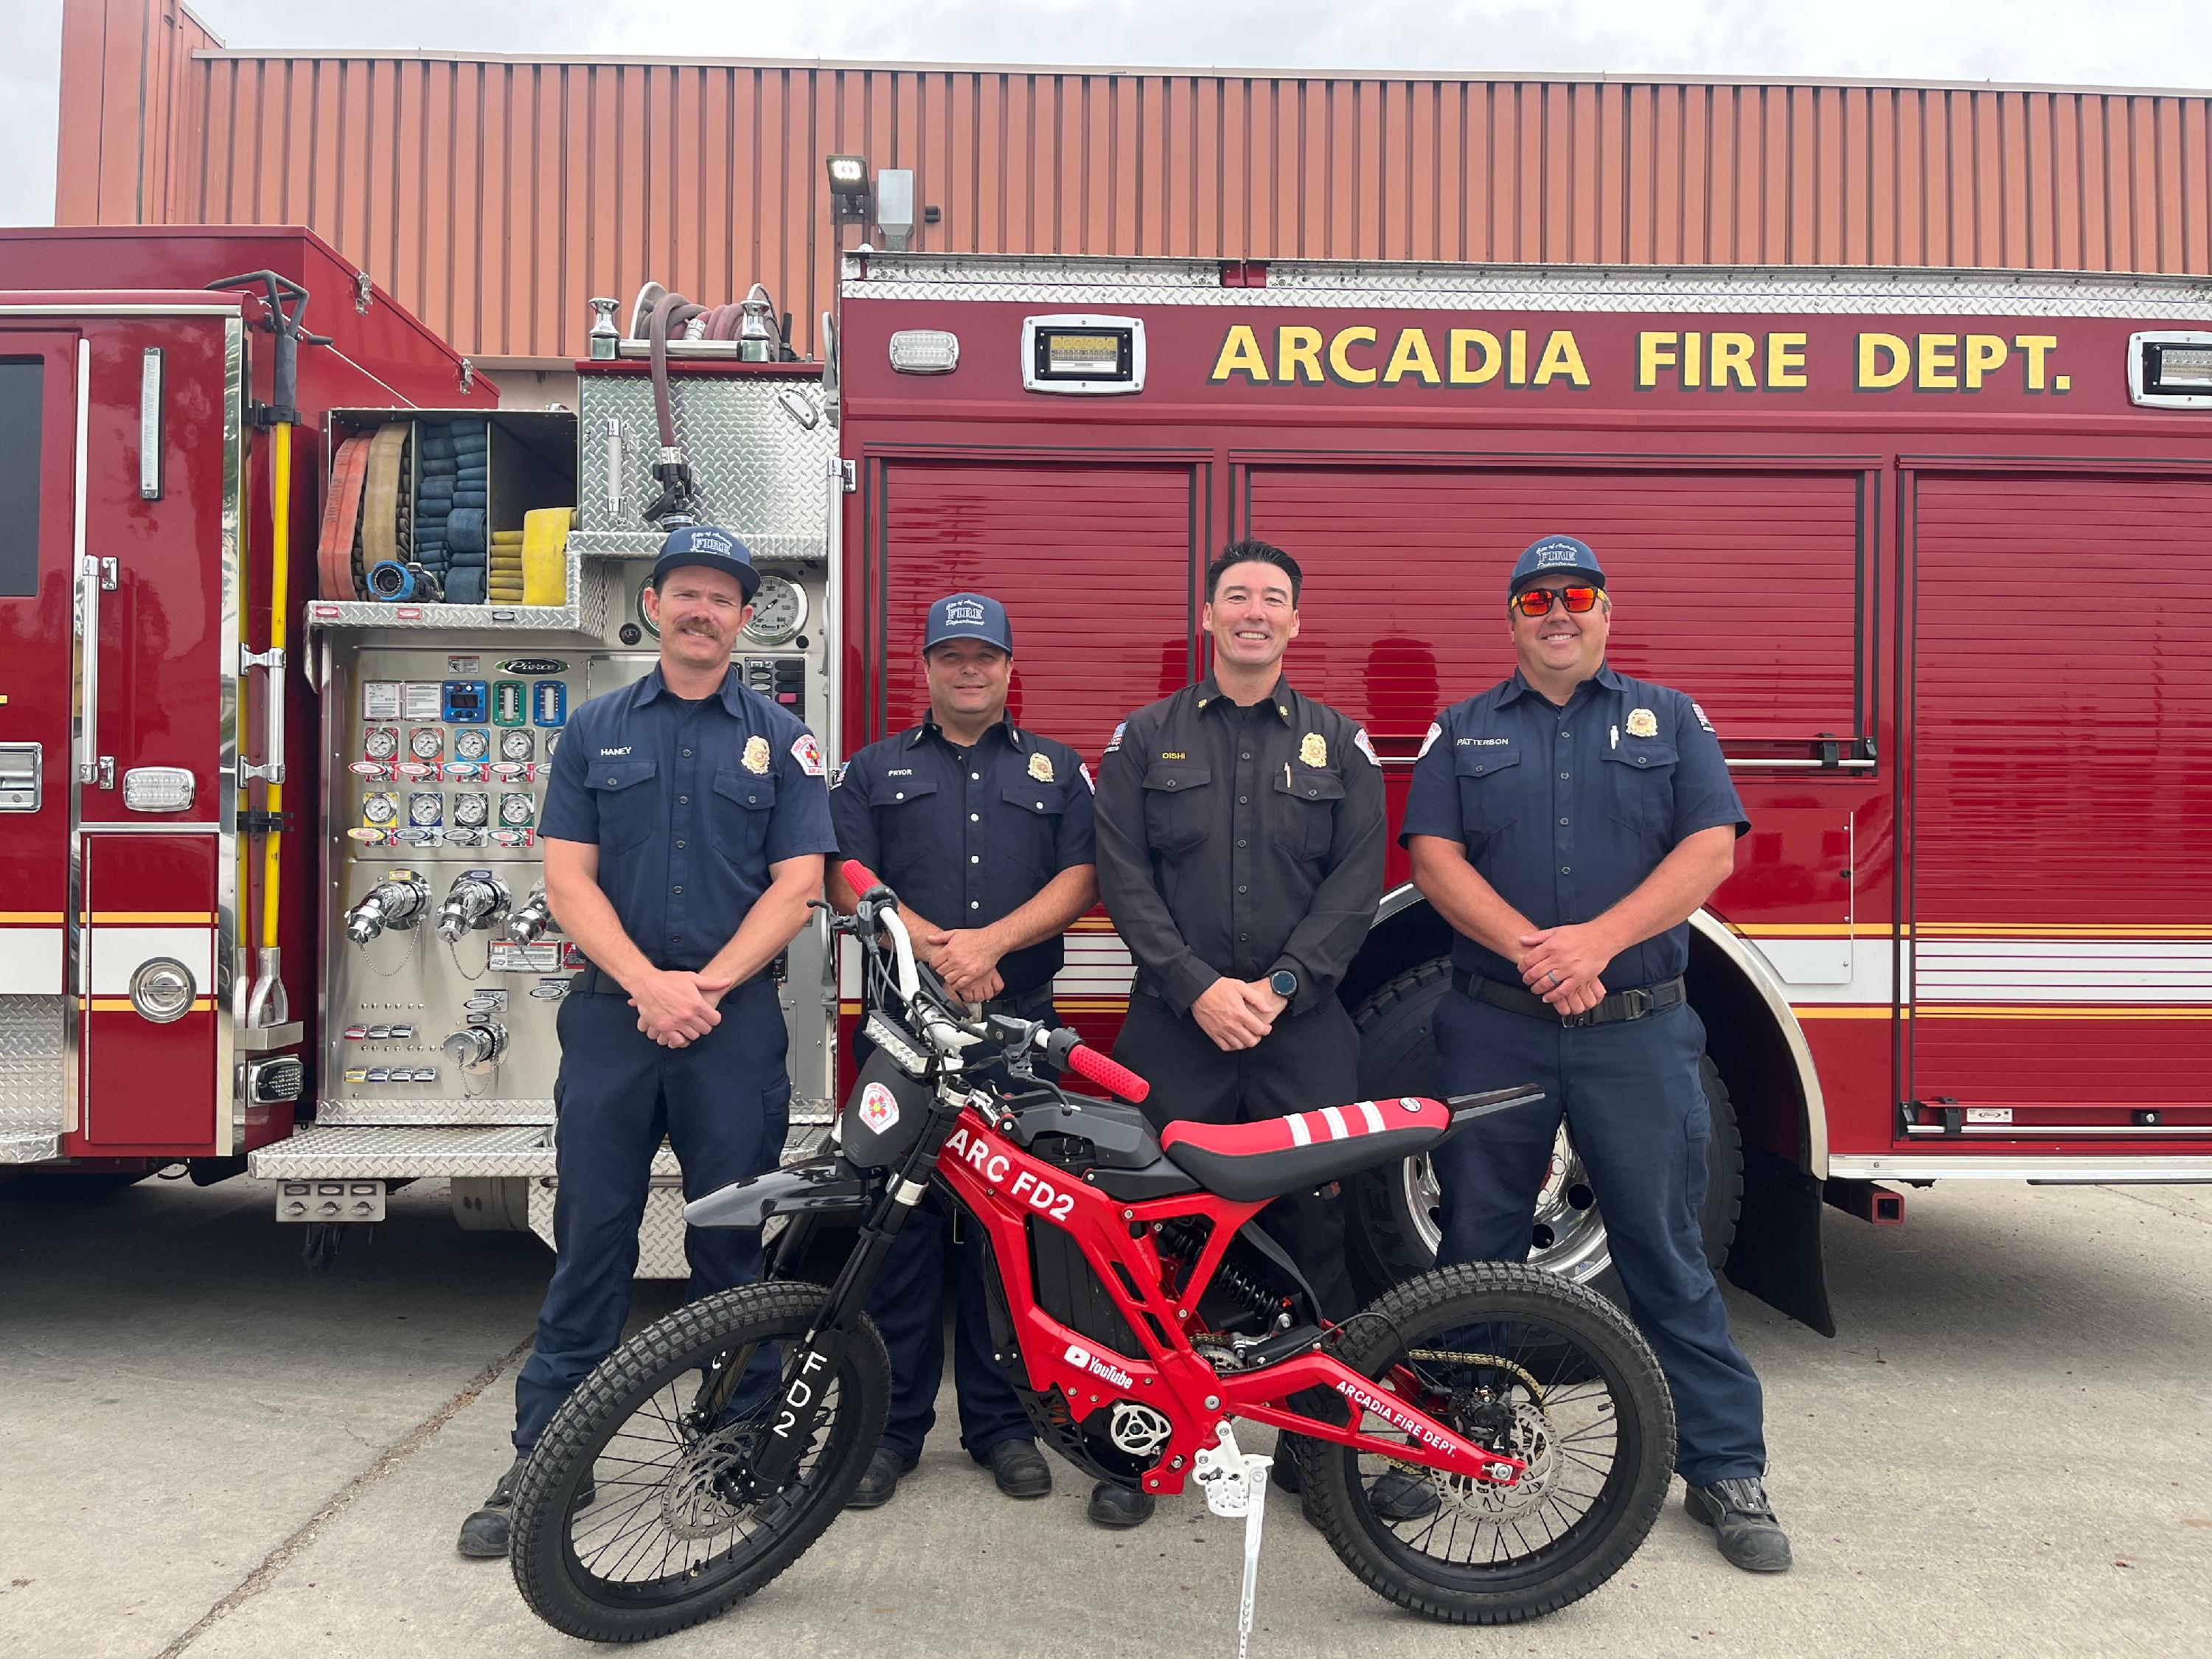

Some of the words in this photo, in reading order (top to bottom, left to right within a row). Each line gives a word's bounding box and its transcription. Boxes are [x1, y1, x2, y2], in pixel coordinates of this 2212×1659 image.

[1207, 324, 1591, 390] ARCADIA
[1634, 331, 1809, 392] FIRE
[1852, 333, 2071, 393] DEPT.
[692, 538, 731, 556] FIRE
[1539, 551, 1576, 563] FIRE
[948, 608, 983, 619] FIRE
[507, 661, 557, 671] Pierce
[600, 746, 631, 755] HANEY
[945, 1127, 1011, 1183] ARC
[1011, 1171, 1075, 1222] FD2
[1088, 1356, 1133, 1389] YouTube
[1336, 1381, 1391, 1419] ARCADIA
[1393, 1413, 1424, 1437] FIRE
[1423, 1430, 1457, 1457] DEPT.
